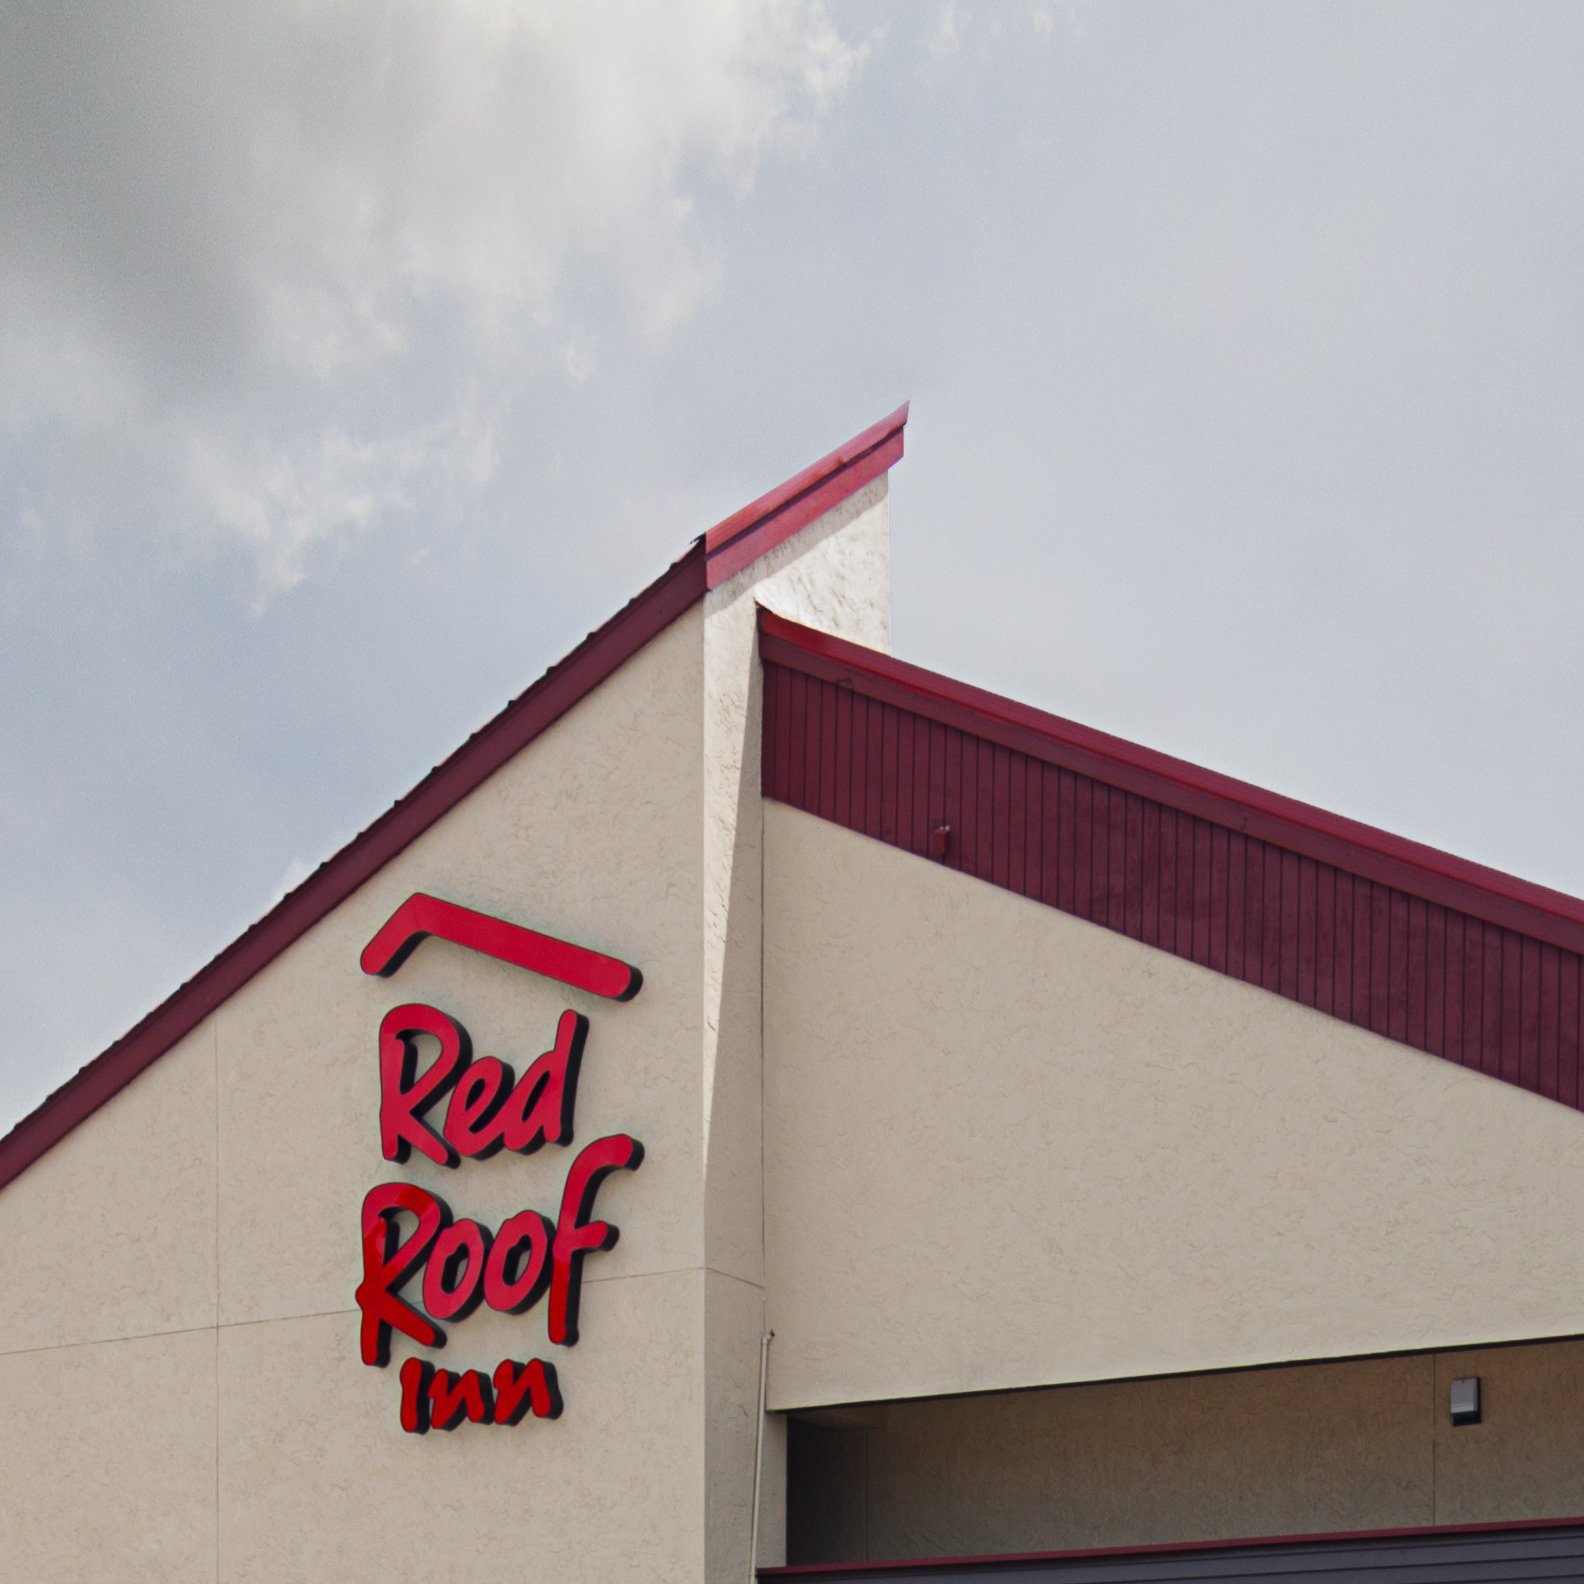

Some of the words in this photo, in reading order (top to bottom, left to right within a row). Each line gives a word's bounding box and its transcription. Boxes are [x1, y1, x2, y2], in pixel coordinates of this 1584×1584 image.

[379, 1003, 588, 1169] Red
[356, 1134, 644, 1367] Roof
[400, 1357, 563, 1434] Inn
